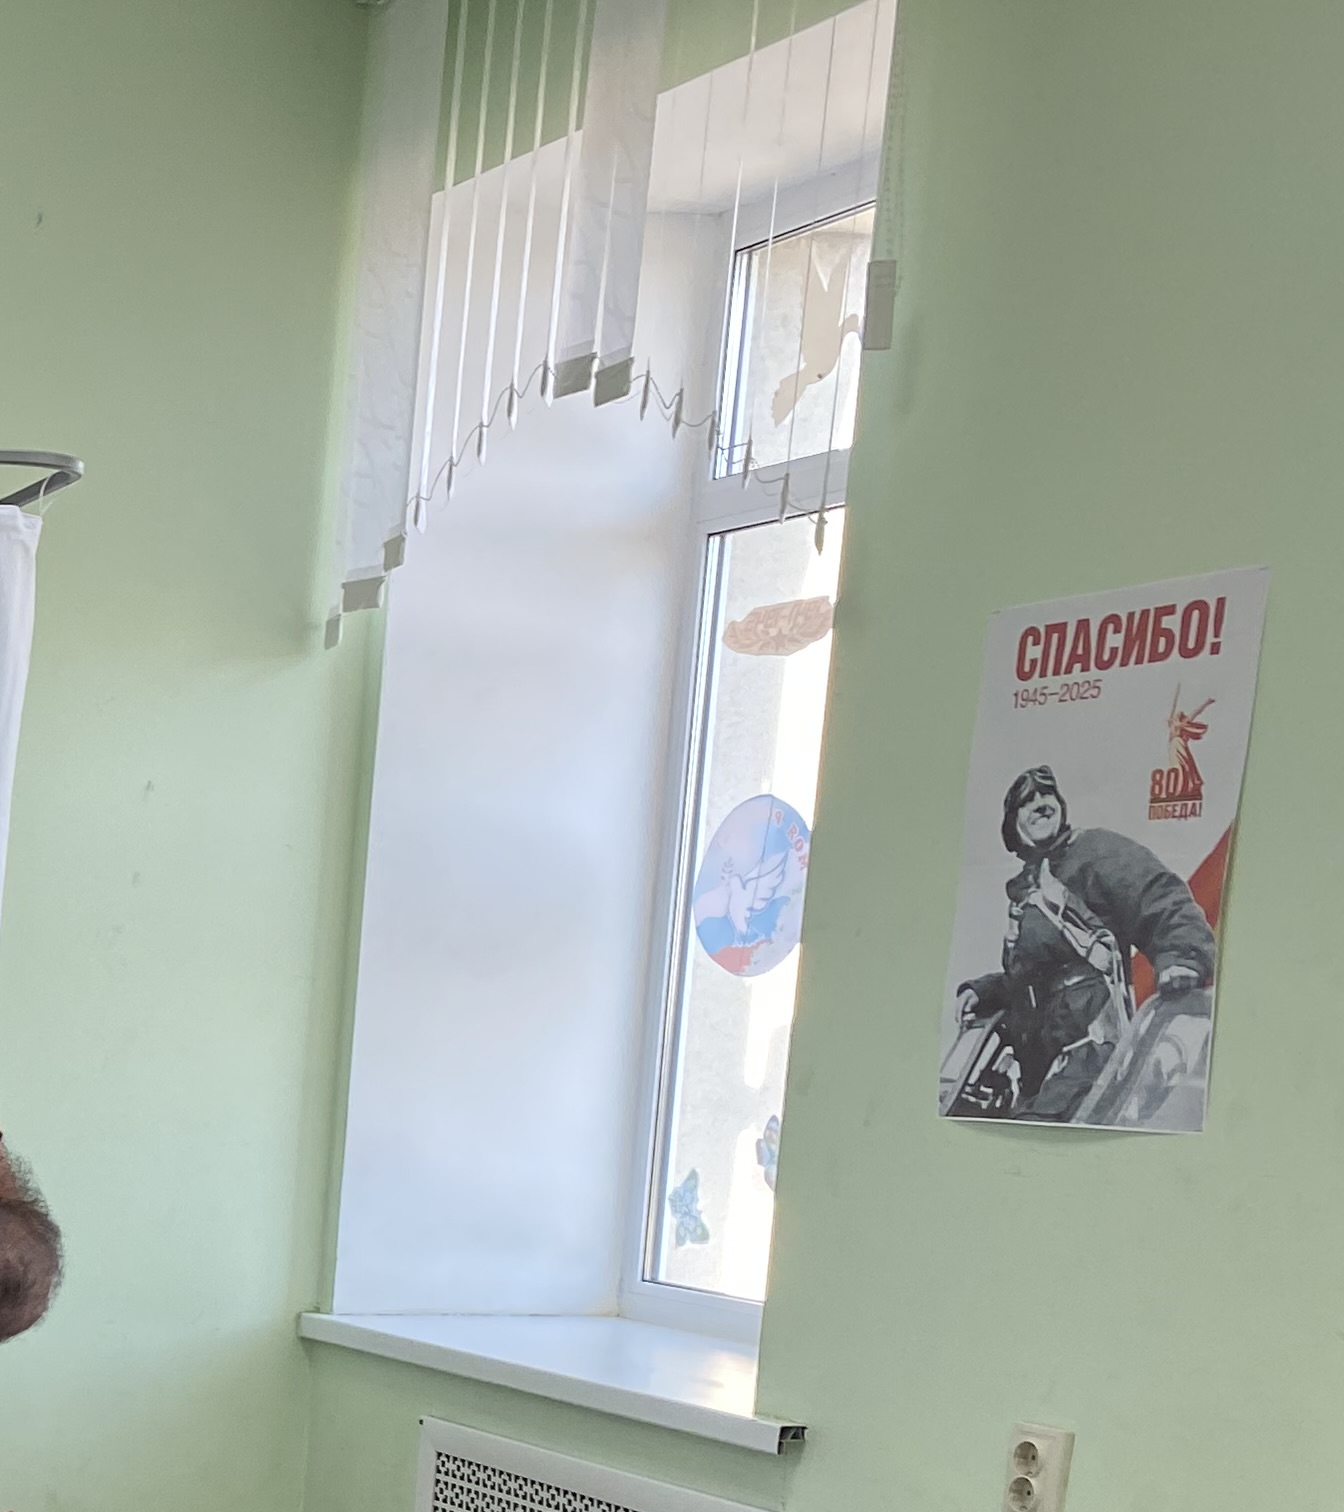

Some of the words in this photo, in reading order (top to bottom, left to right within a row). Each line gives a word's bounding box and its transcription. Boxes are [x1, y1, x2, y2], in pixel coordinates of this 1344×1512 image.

[1015, 596, 1227, 682] СПАСИБО!
[1150, 768, 1181, 799] 80
[1147, 802, 1203, 821] ПОБЕДА!
